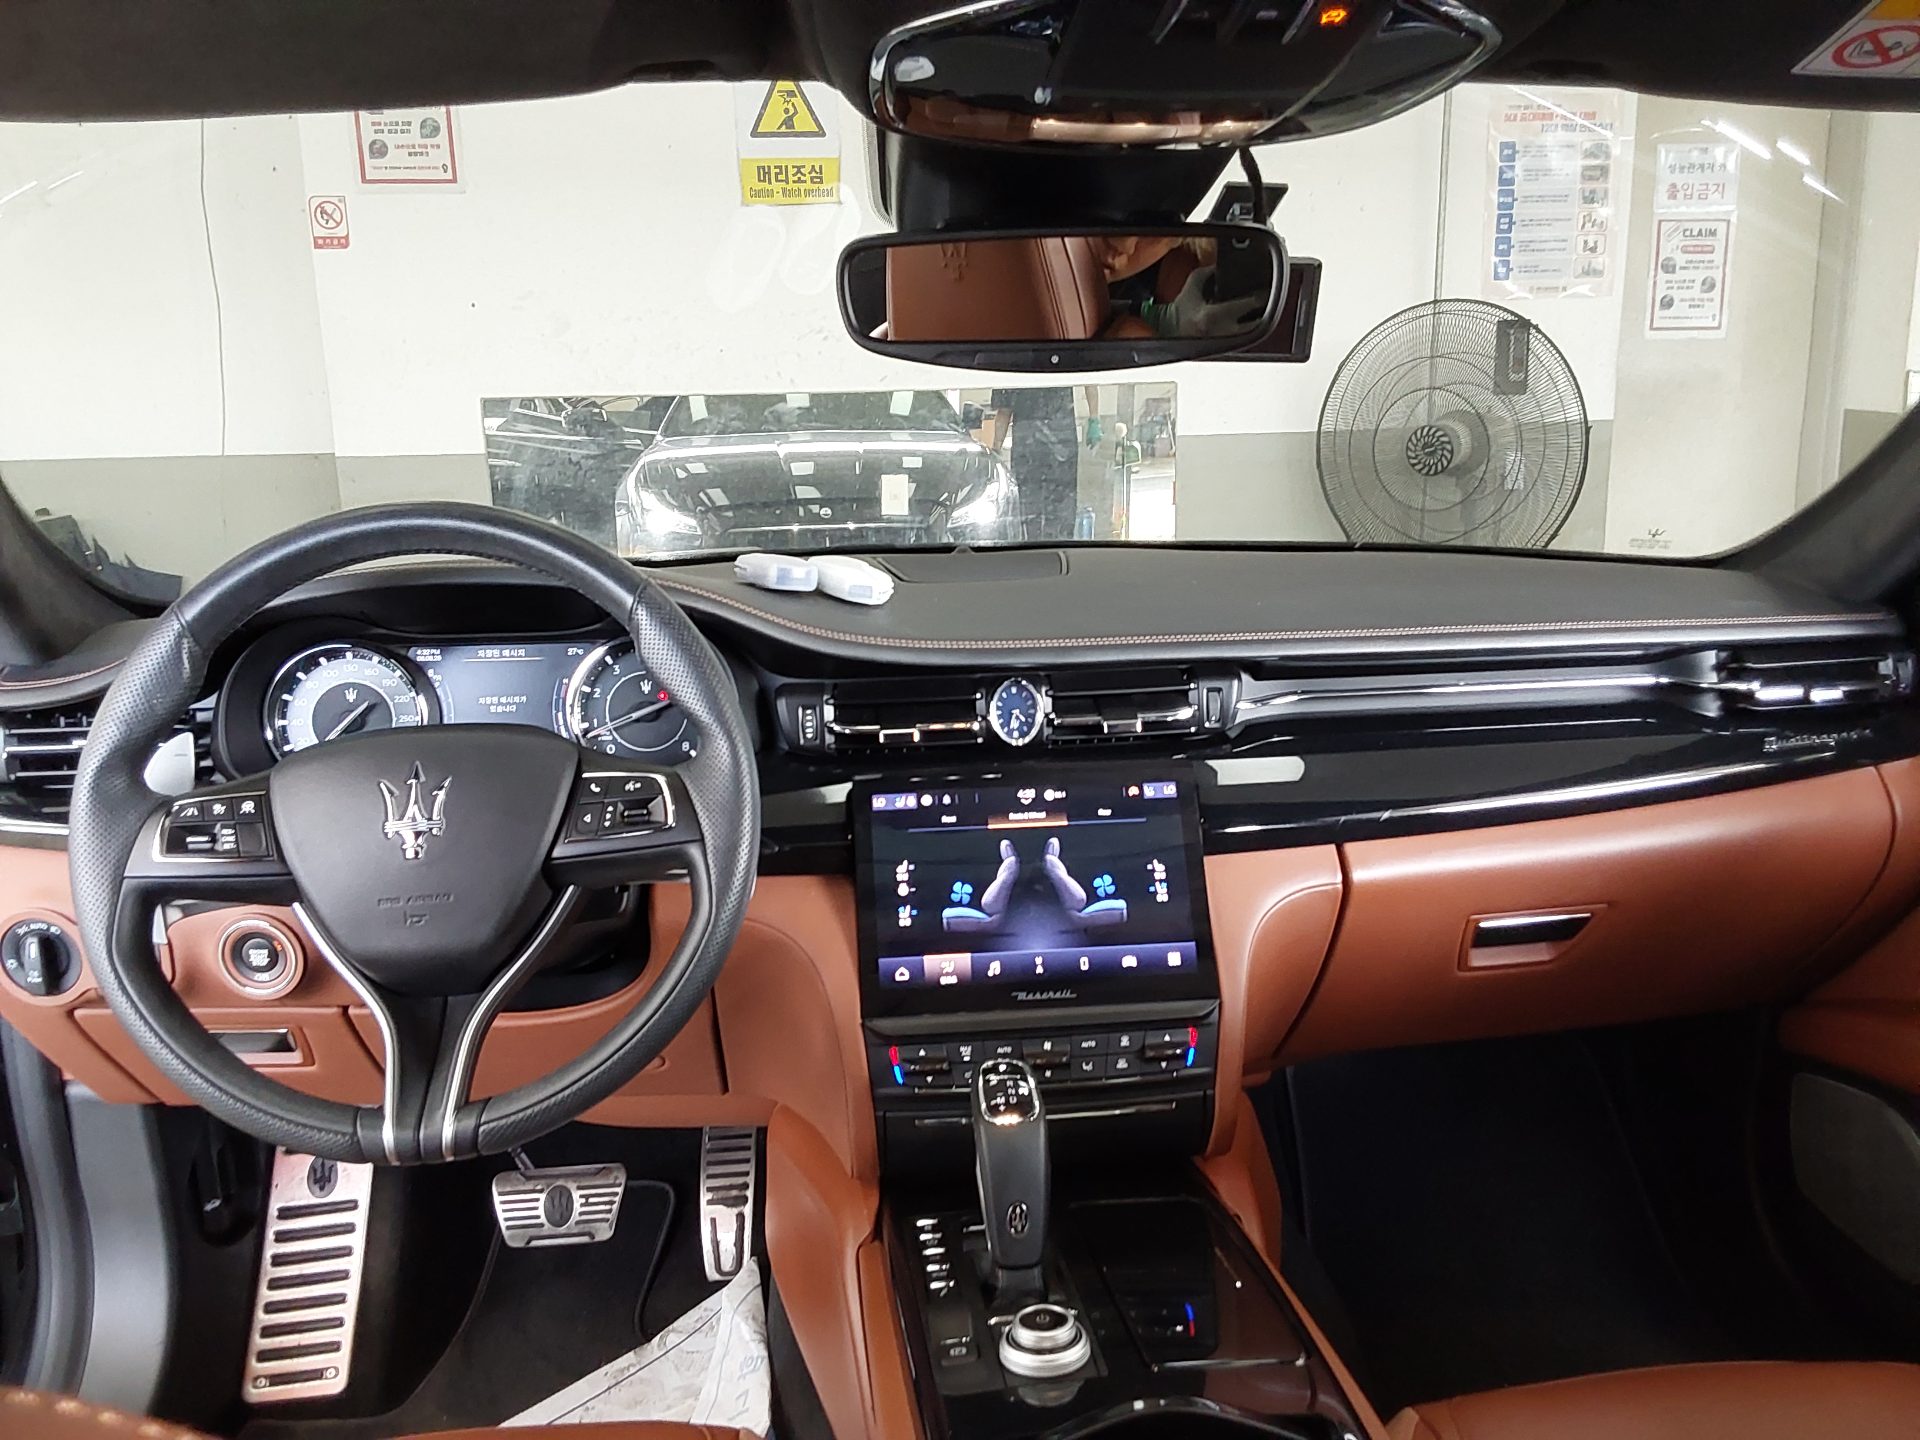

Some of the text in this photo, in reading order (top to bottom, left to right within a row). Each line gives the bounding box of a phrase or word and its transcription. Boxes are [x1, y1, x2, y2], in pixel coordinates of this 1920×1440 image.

[756, 164, 824, 185] 머리조심
[749, 187, 775, 199] Caution
[781, 186, 802, 198] Watch
[803, 186, 834, 198] overhead
[1666, 182, 1726, 200] 출입금지
[1682, 228, 1718, 238] CLAIM
[322, 669, 339, 678] 100
[364, 667, 379, 676] 160
[612, 665, 620, 675] 3
[382, 678, 397, 687] 190
[593, 688, 601, 698] 2
[394, 695, 410, 703] 220
[290, 718, 304, 726] 40
[398, 715, 414, 723] 250
[593, 718, 598, 728] 1
[606, 745, 615, 754] 0
[681, 741, 690, 751] 8
[1081, 1040, 1097, 1048] AUTO
[997, 1046, 1012, 1054] AUTO
